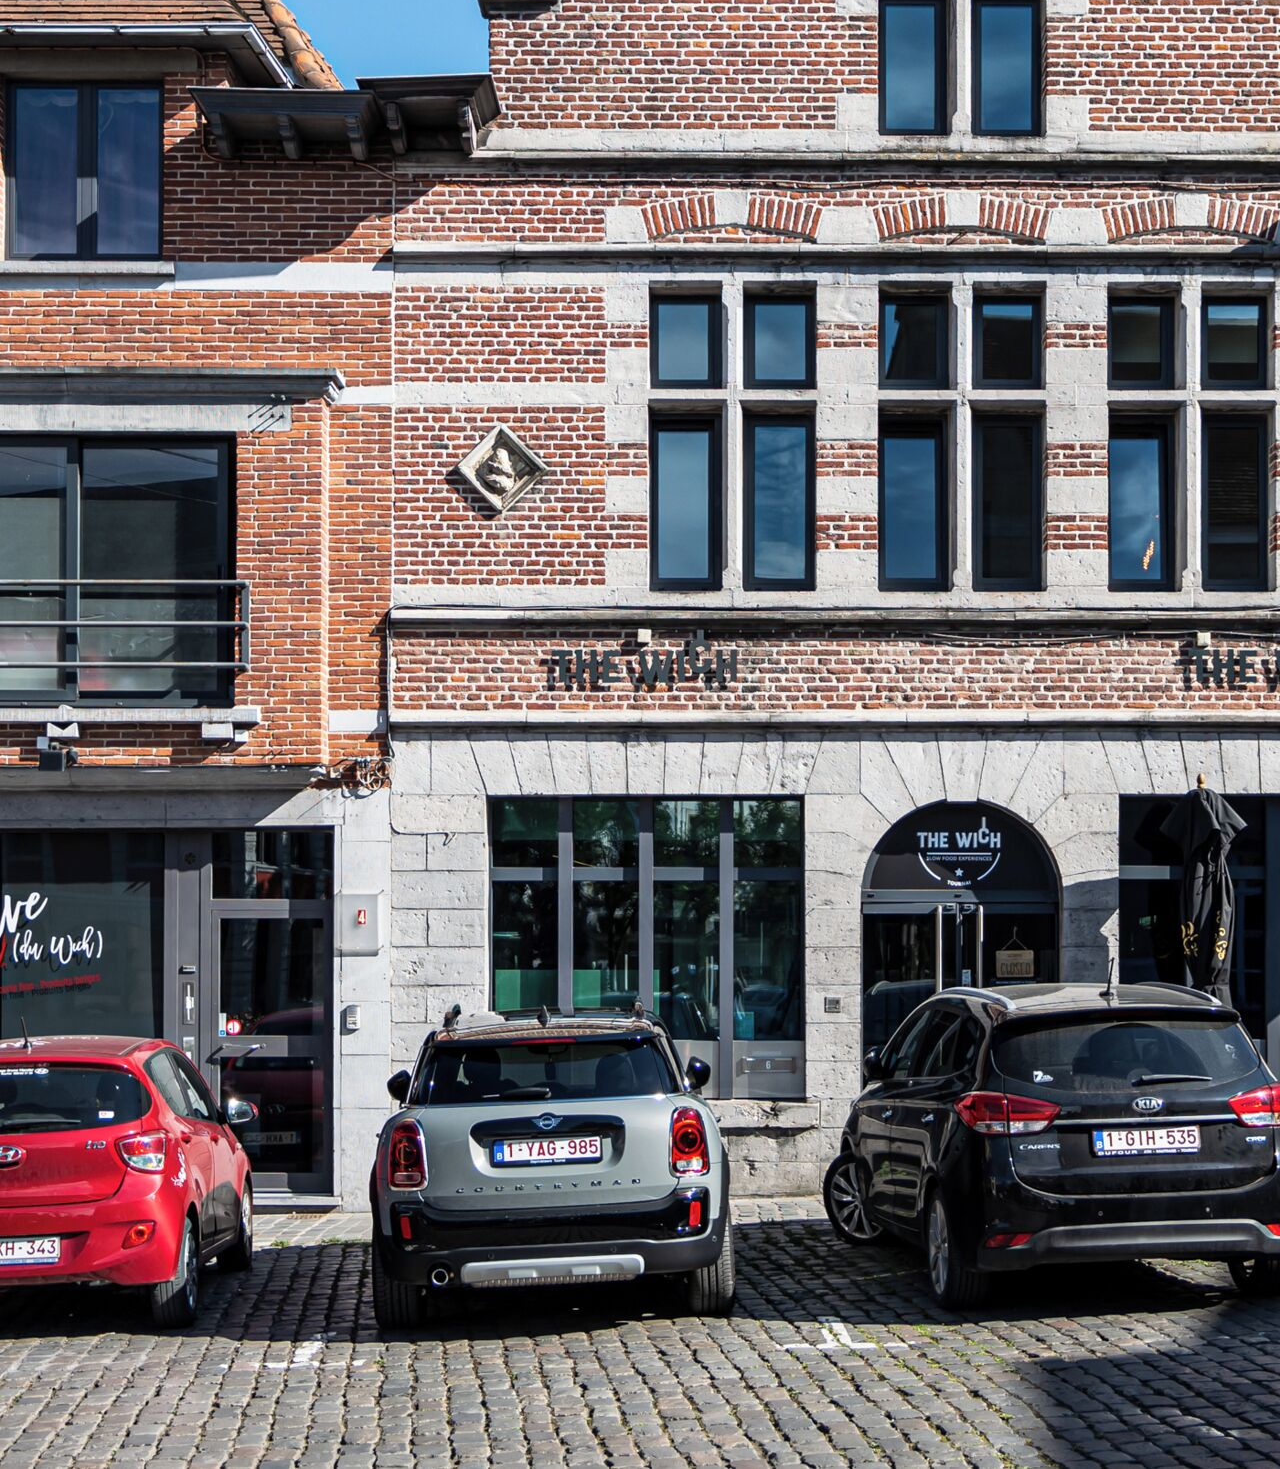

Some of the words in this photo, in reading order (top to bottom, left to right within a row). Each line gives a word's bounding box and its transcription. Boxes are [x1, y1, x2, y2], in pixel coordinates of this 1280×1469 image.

[552, 649, 622, 683] THE
[638, 629, 738, 686] WICH
[1189, 648, 1259, 683] THE
[916, 832, 949, 849] THE
[955, 816, 1001, 849] WICH
[358, 910, 366, 924] 4
[765, 1060, 772, 1070] 6
[1136, 1099, 1163, 1110] KIA
[1019, 1142, 1061, 1151] CARENS
[1106, 1129, 1197, 1147] 1-GIH-535
[506, 1139, 599, 1158] 1-YAG-985
[455, 1177, 642, 1194] COUNTRYMAN
